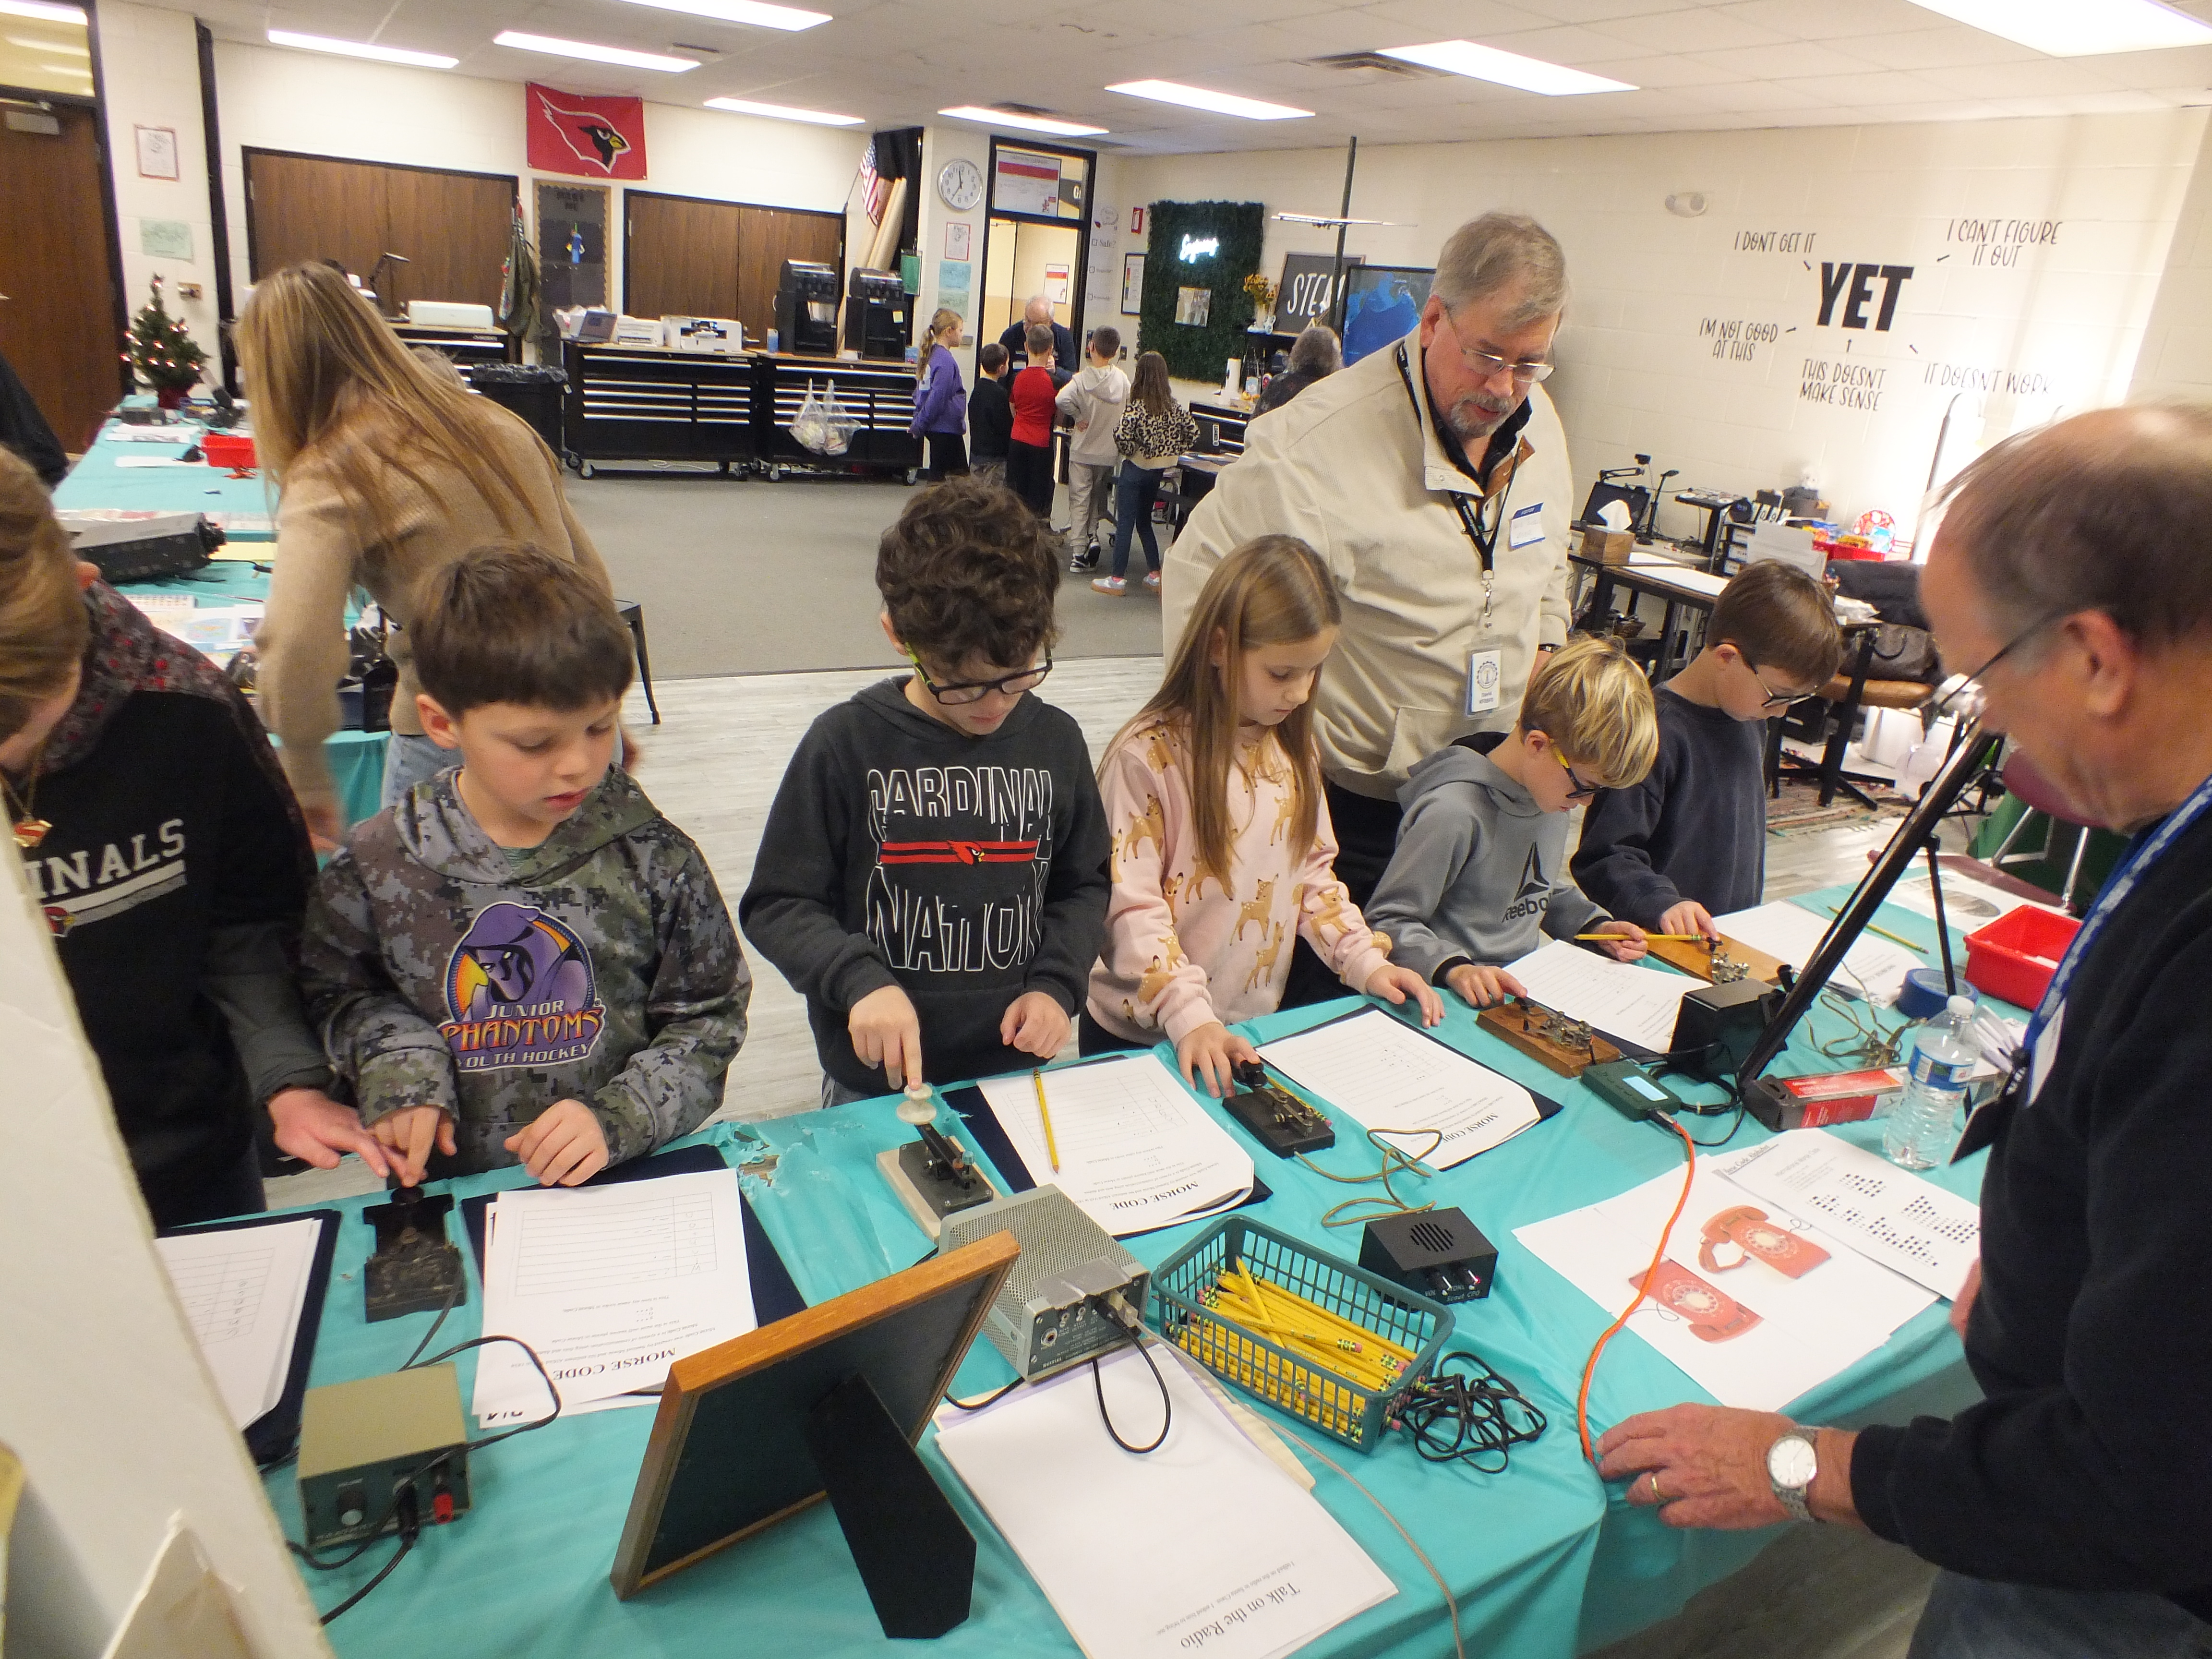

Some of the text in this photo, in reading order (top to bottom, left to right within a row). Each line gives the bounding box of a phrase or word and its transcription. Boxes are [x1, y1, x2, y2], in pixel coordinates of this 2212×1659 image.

[1735, 231, 1740, 250] I
[1779, 233, 1801, 252] GET
[1804, 233, 1816, 253] IT
[1947, 219, 1954, 241] I
[2004, 219, 2063, 245] FIGURE
[1972, 244, 2023, 268] IT OUT
[1816, 262, 1914, 331] YET
[1719, 320, 1743, 340] NOT
[1745, 323, 1778, 343] GOOD
[1713, 339, 1755, 361] AT THIS
[1802, 359, 1827, 381] THIS
[1924, 363, 1938, 384] IT
[2006, 372, 2056, 395] WORK
[1800, 381, 1883, 411] MAKE SENSE
[484, 999, 565, 1020] JUNIOR
[441, 1008, 601, 1052] PHANTOMS
[522, 1043, 590, 1063] HOCKEY
[1463, 1115, 1498, 1131] MORSE
[1149, 1183, 1198, 1201] MORSE
[1108, 1199, 1147, 1209] CODE
[553, 1350, 678, 1379] MORSE CODE
[1181, 1583, 1300, 1647] Talk on the Radio
